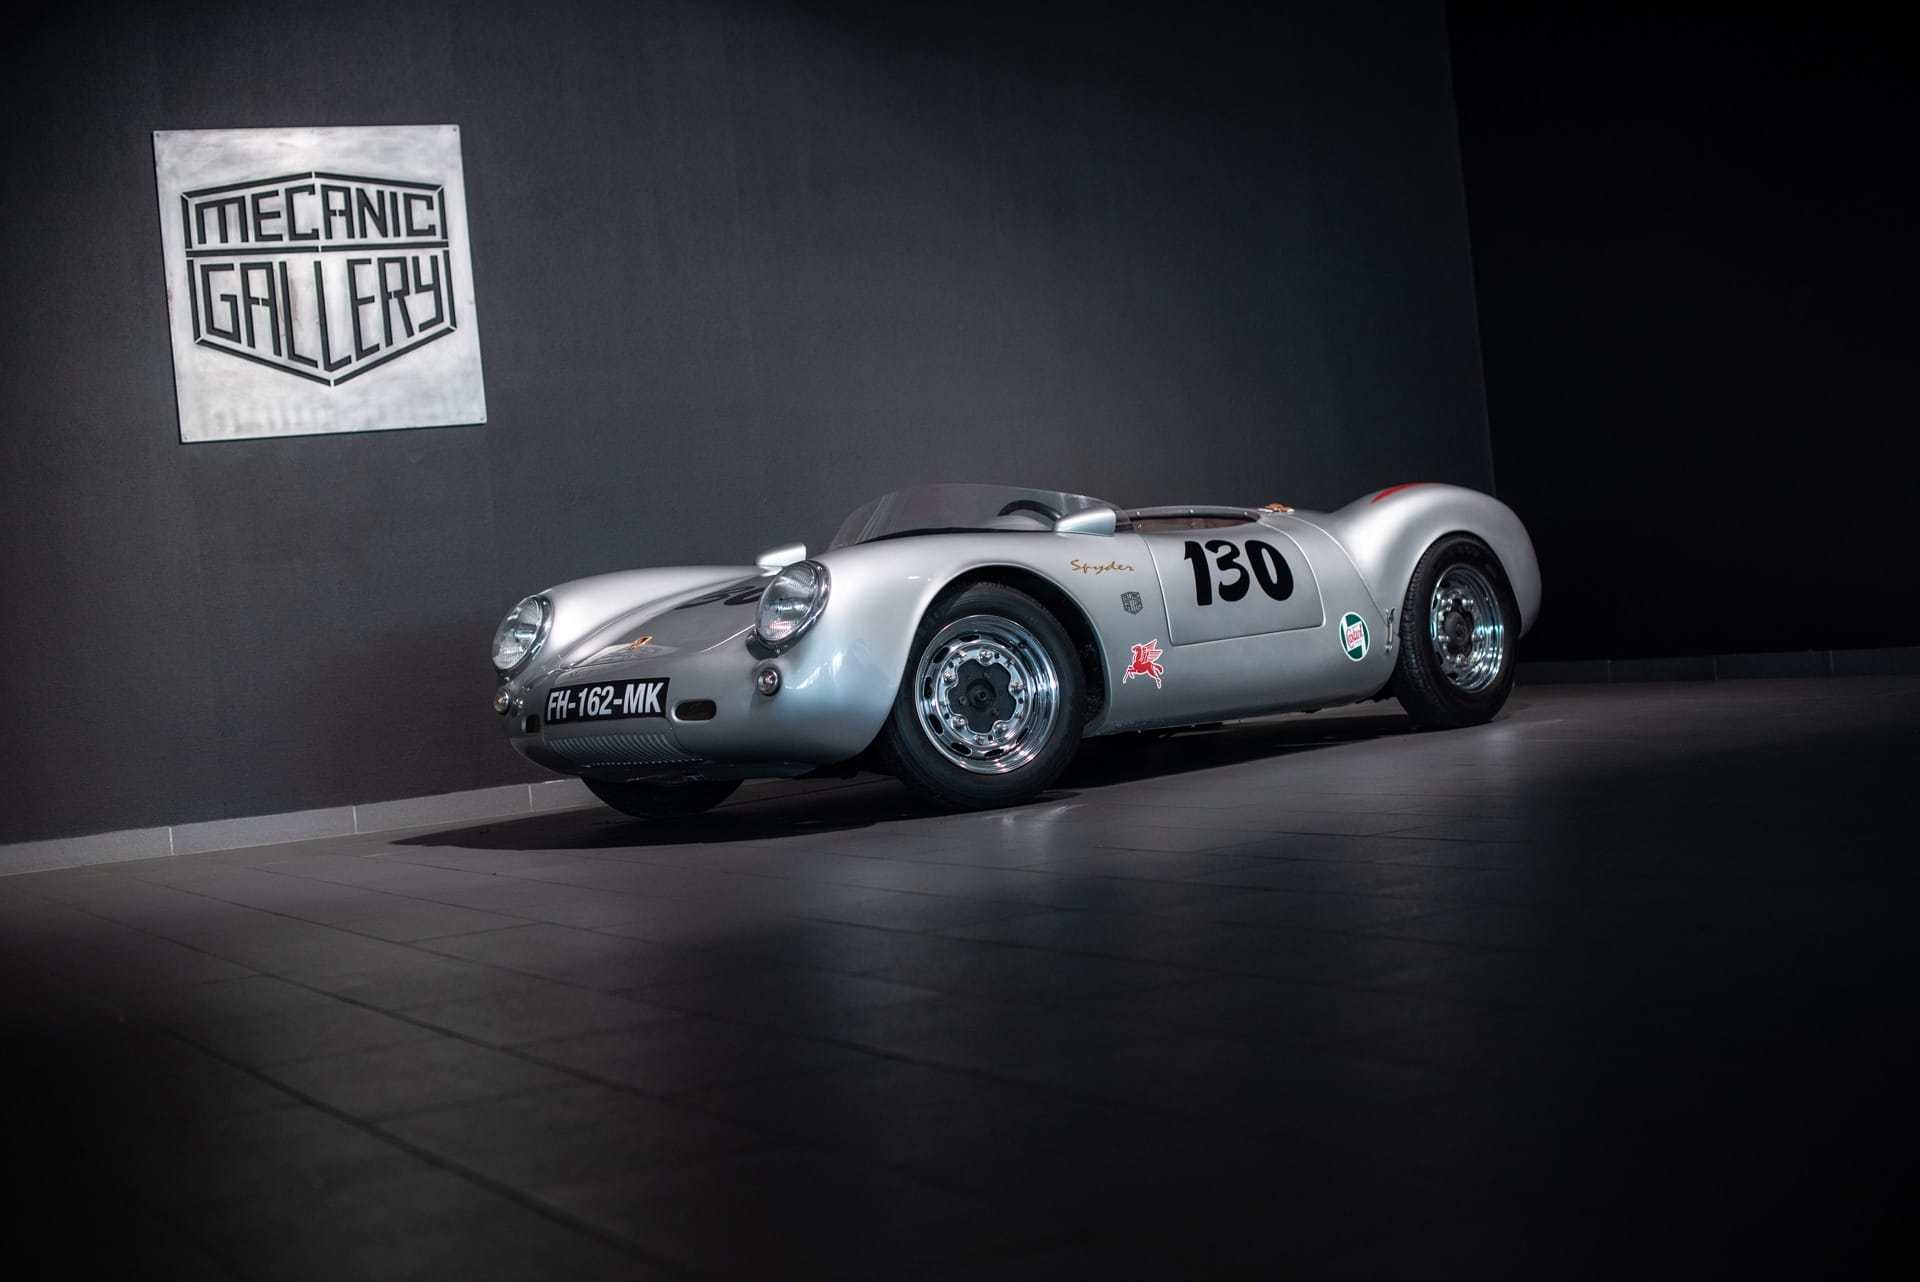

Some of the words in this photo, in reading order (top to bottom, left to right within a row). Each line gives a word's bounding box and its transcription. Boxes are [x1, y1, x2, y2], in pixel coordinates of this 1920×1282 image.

[194, 183, 437, 245] MECANIC
[200, 254, 445, 373] GALLERY
[1069, 559, 1135, 575] Spyder
[1183, 539, 1294, 606] 130
[547, 682, 664, 721] FH-162-MK
